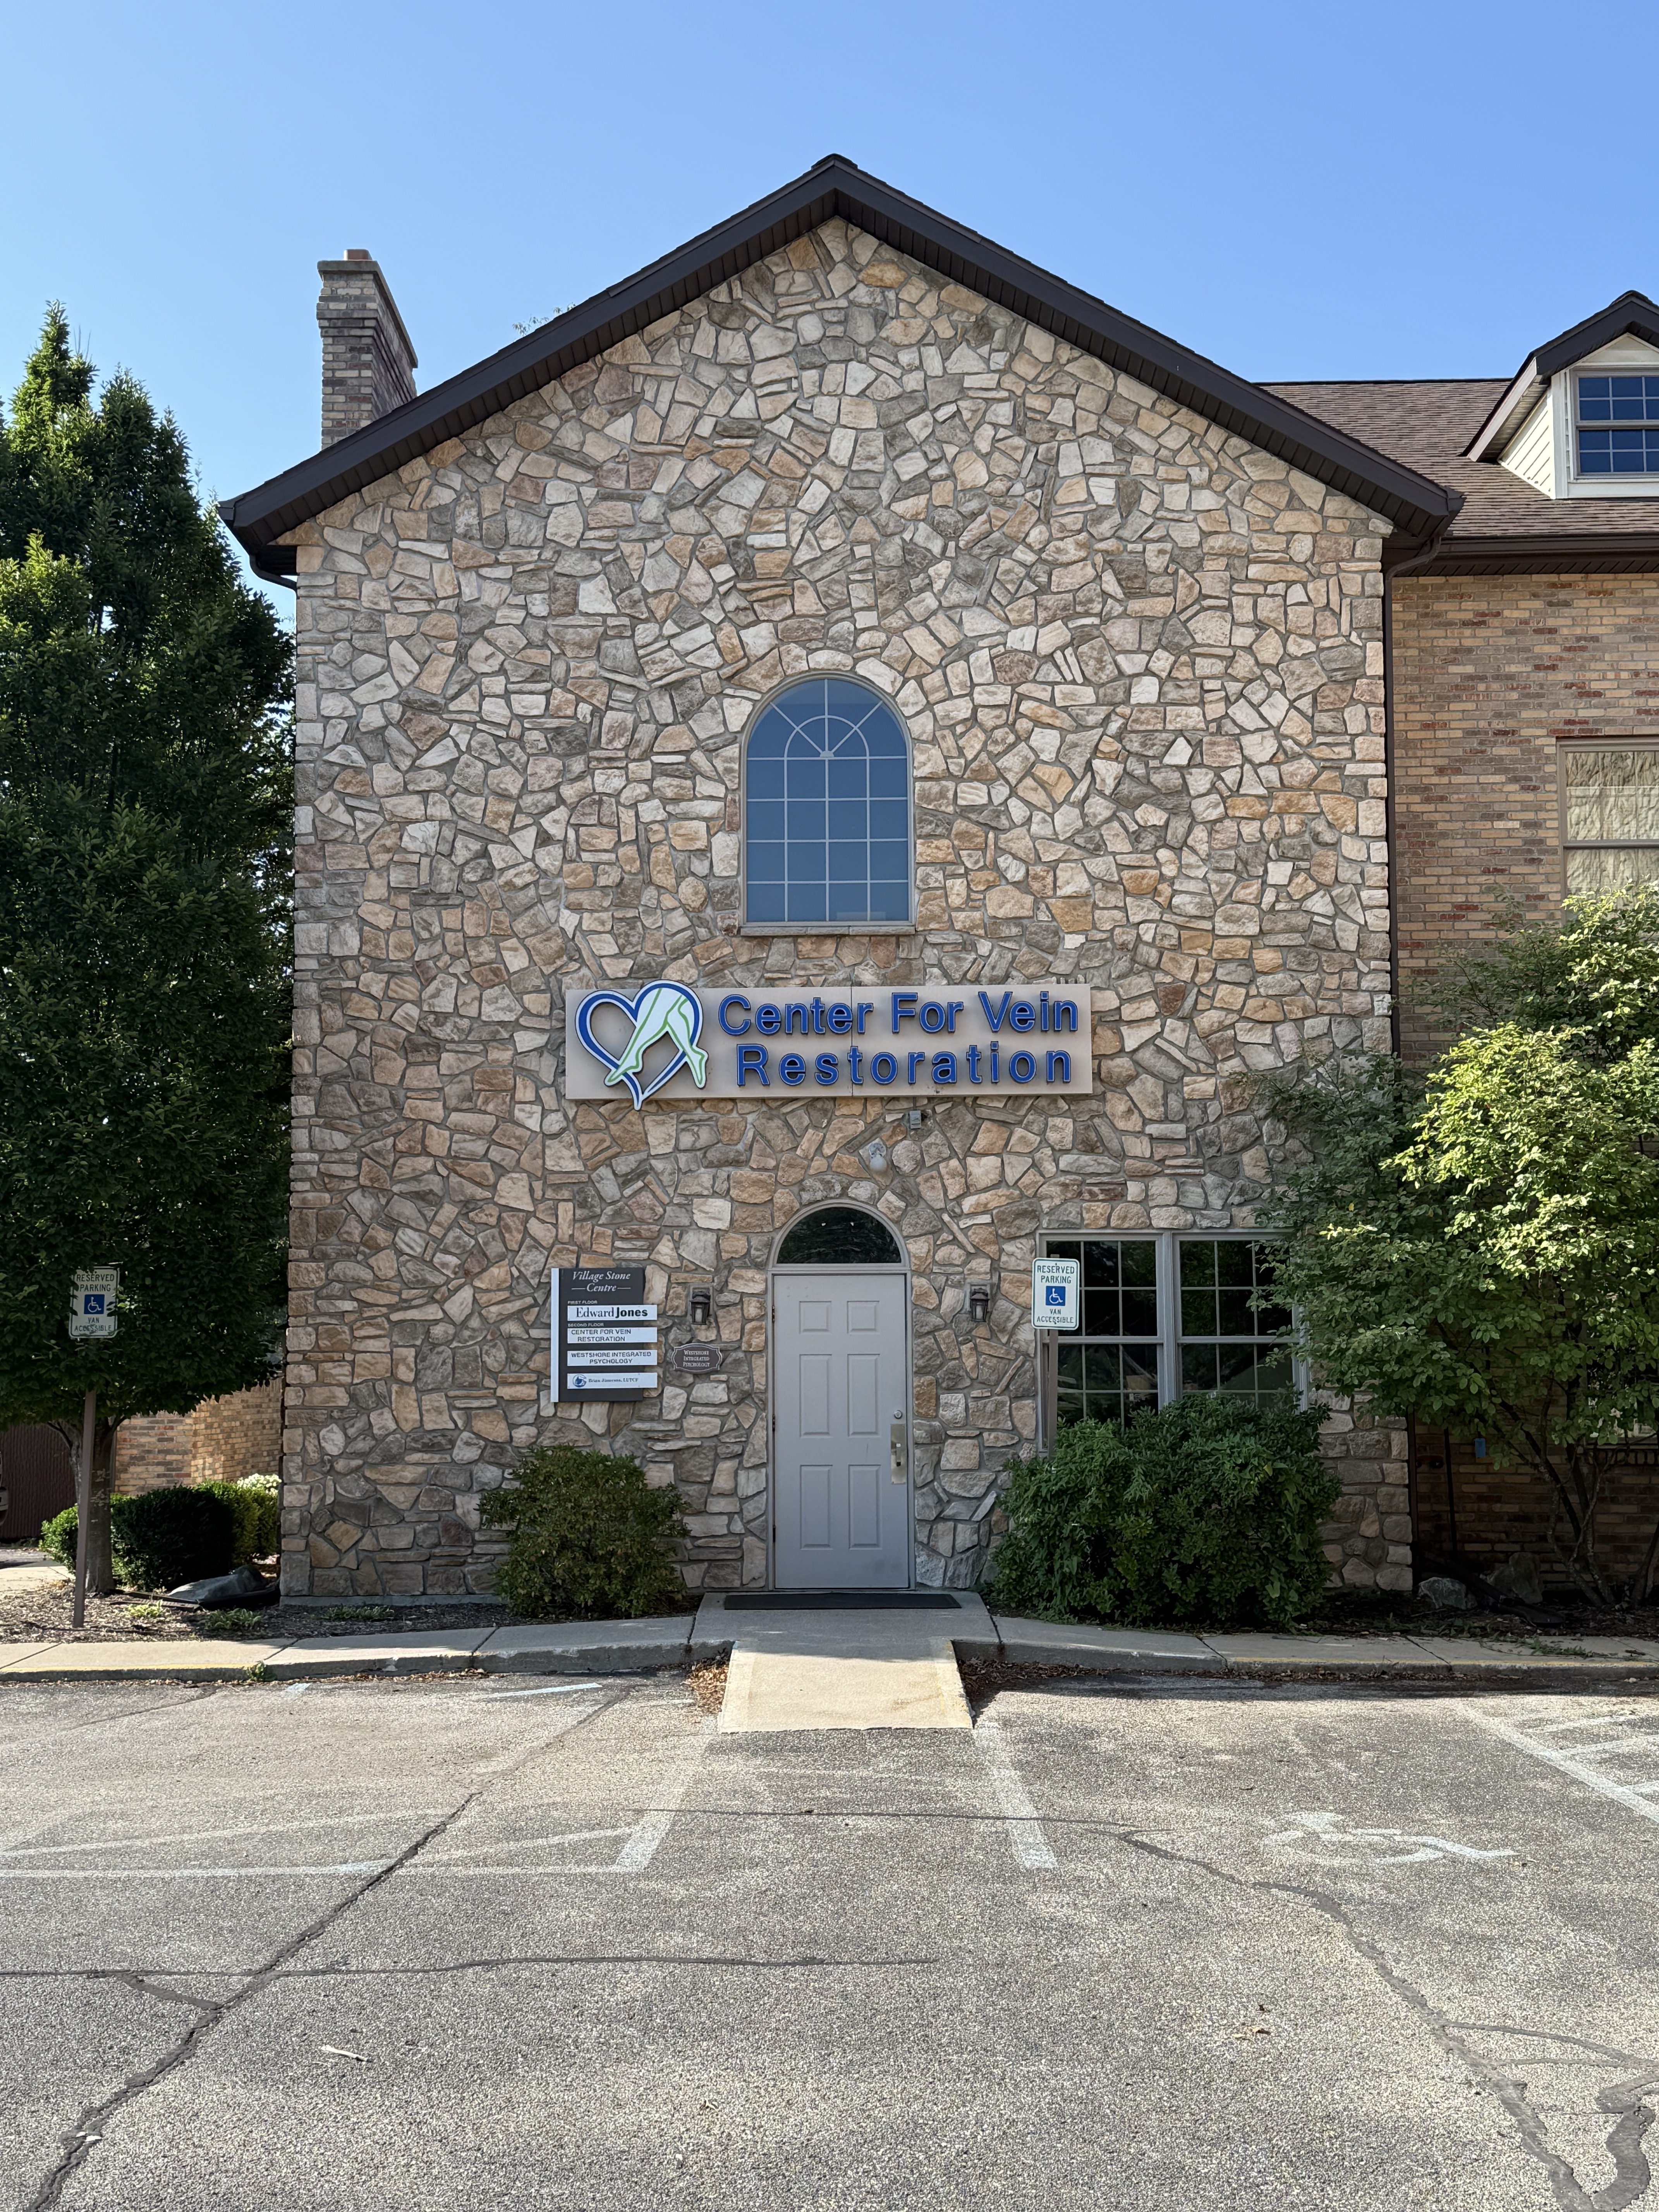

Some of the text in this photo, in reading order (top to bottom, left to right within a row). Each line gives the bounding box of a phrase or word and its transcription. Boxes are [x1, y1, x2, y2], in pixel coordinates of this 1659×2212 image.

[718, 990, 1078, 1035] Center For Vein
[737, 1041, 1072, 1087] Restoration
[1037, 1265, 1075, 1274] RESERVED
[573, 1271, 631, 1283] Village Stone
[587, 1283, 617, 1292] Centre
[576, 1307, 648, 1318] Edward Jones
